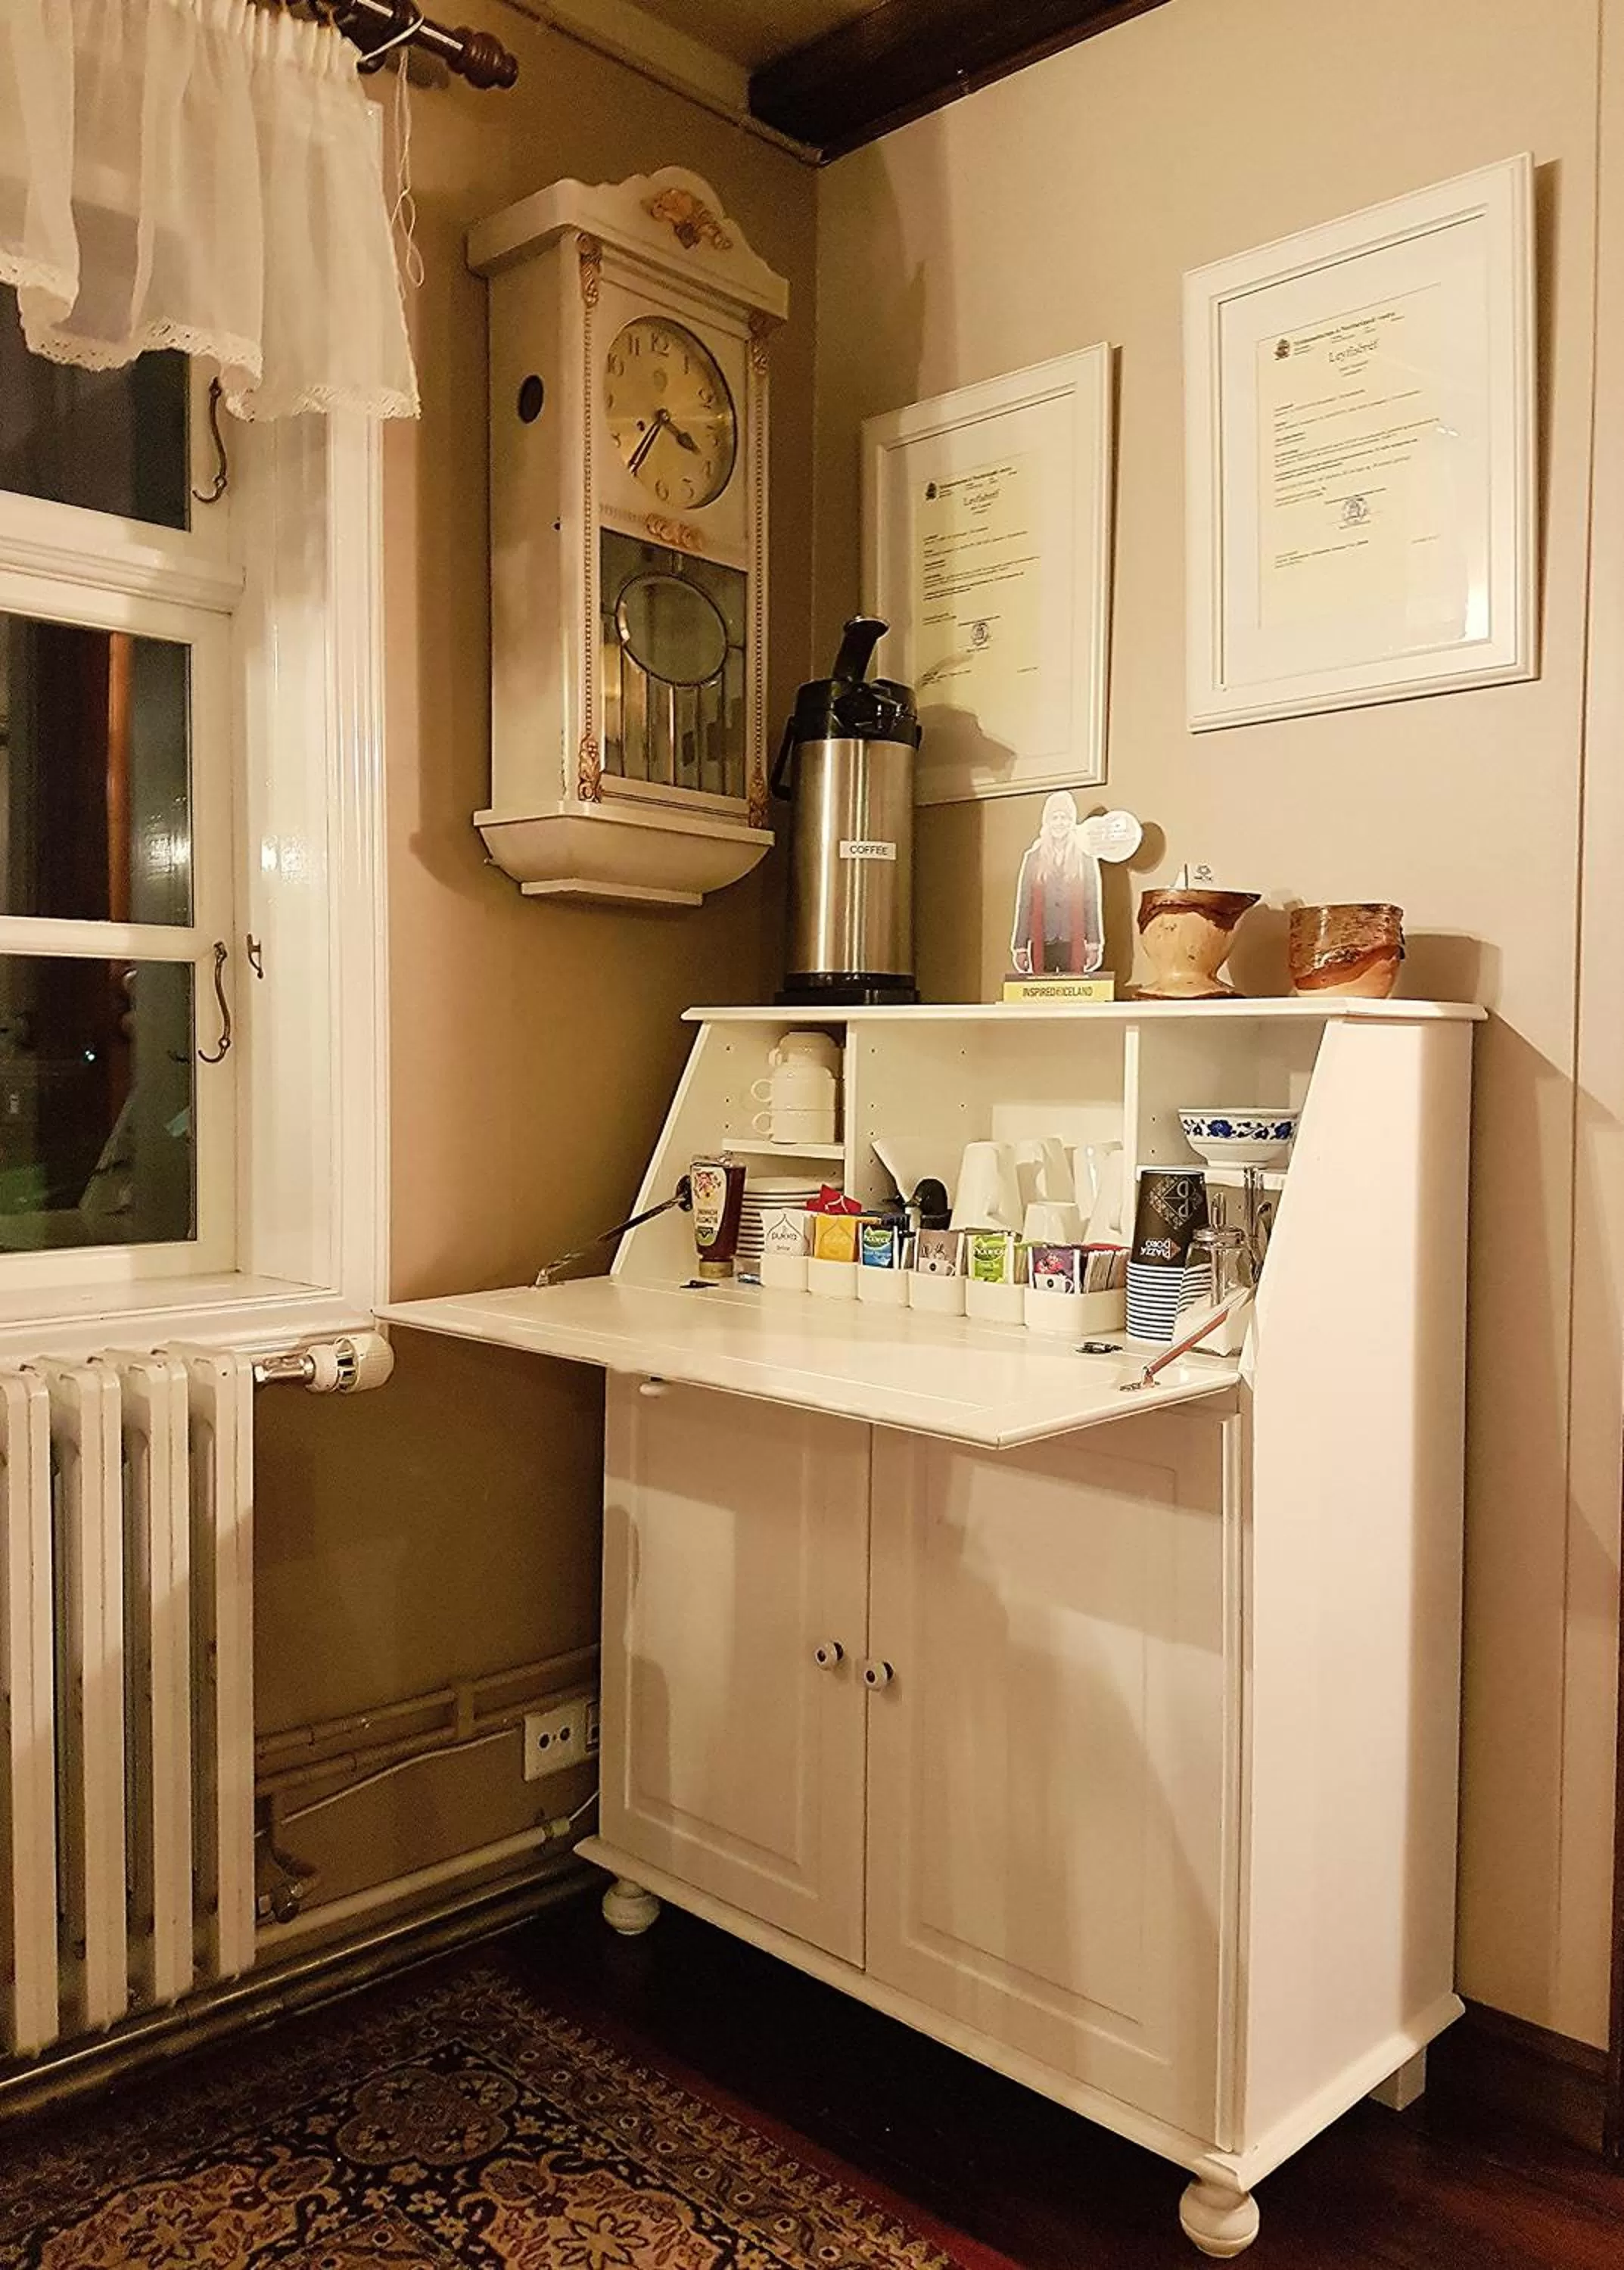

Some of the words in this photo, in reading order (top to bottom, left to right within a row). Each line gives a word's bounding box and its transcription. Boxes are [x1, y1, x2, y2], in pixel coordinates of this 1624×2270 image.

[628, 333, 640, 356] 11
[651, 331, 670, 357] 12
[683, 354, 690, 375] 1
[655, 479, 670, 501] 6
[849, 844, 888, 856] COFFEE
[1140, 1246, 1171, 1258] PIAZZA
